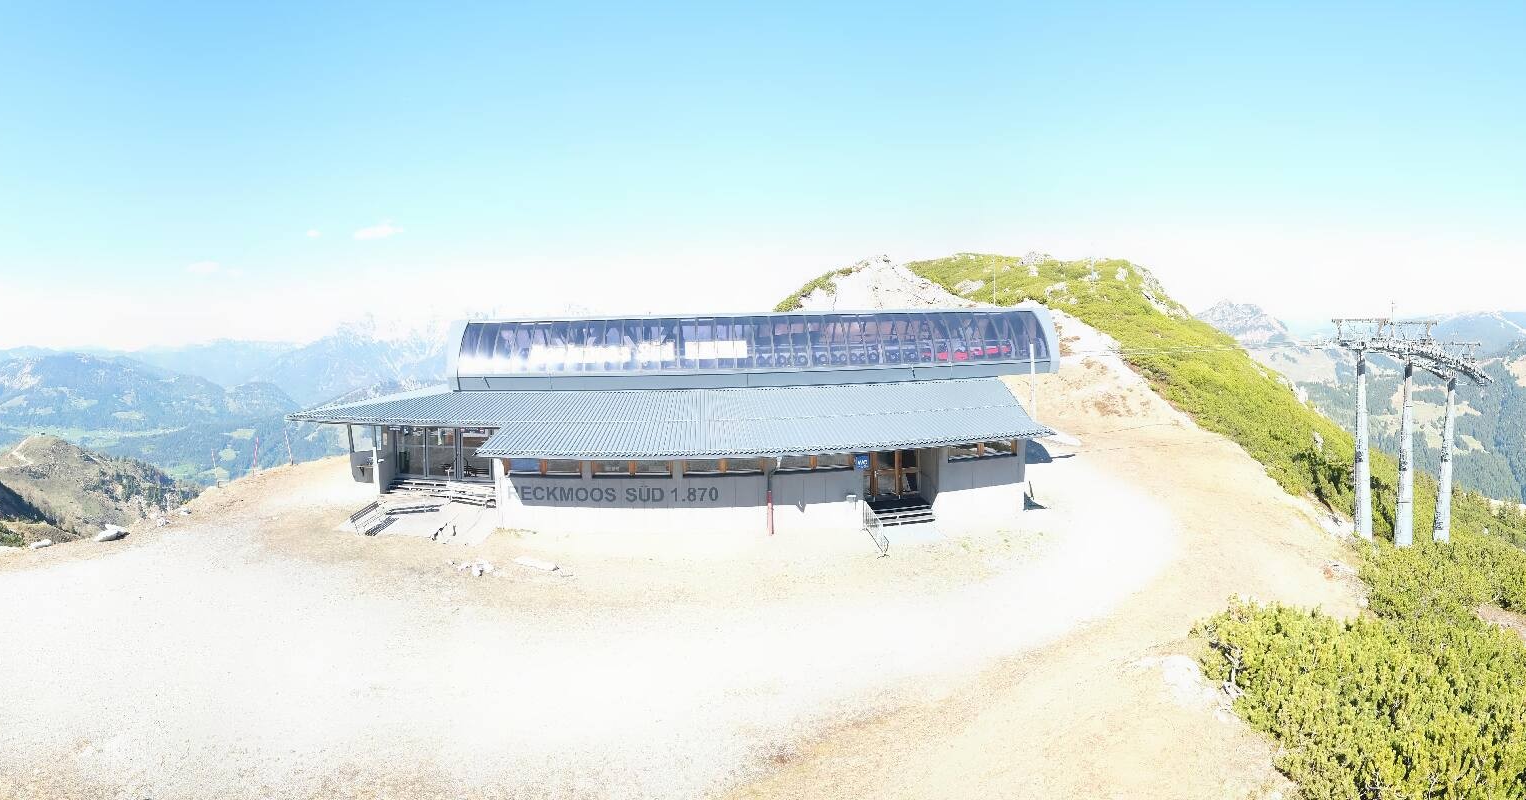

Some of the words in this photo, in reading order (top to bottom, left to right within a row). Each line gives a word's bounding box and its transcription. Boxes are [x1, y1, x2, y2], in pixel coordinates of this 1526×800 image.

[508, 485, 616, 502] RECKMOOS
[625, 485, 664, 502] SÜD
[670, 486, 719, 502] 1.870
